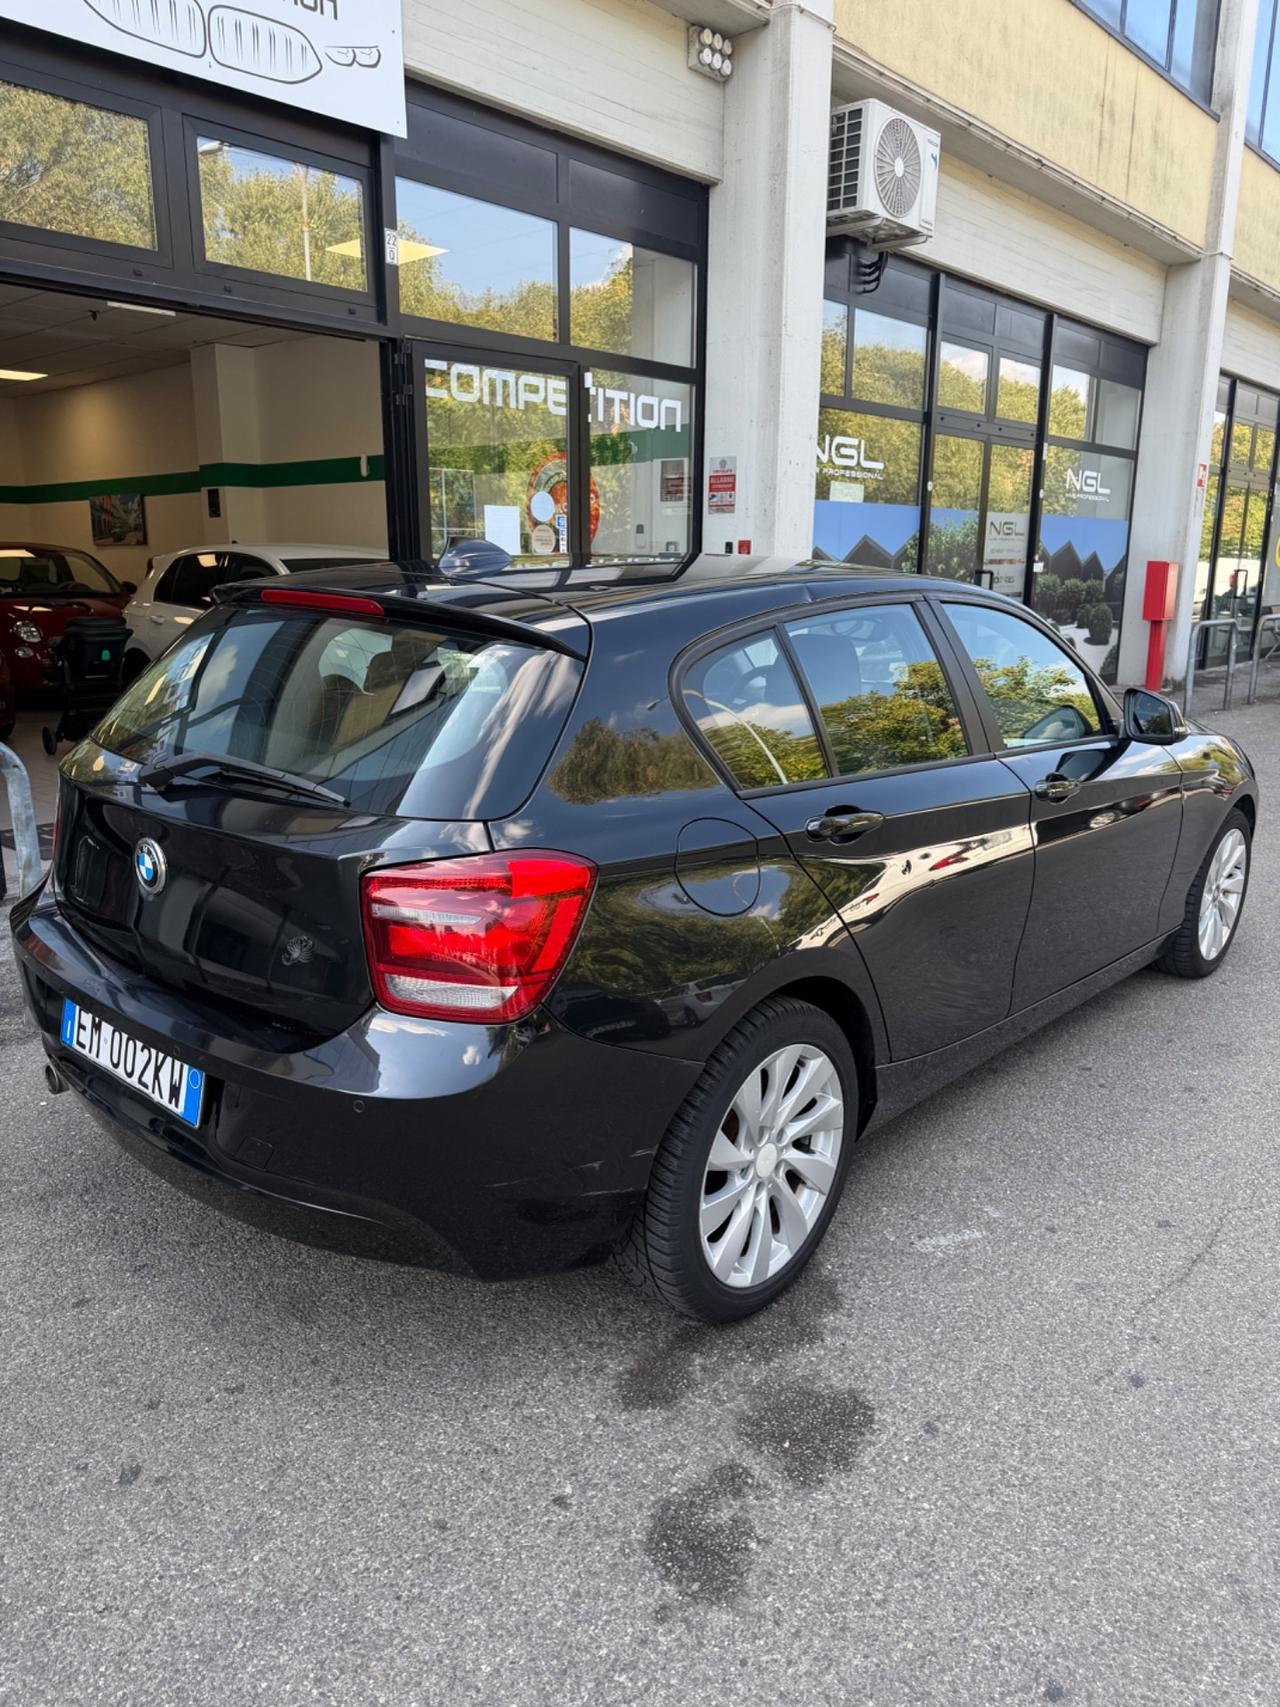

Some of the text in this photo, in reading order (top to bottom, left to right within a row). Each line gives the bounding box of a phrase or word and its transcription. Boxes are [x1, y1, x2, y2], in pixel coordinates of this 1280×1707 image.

[424, 358, 682, 432] COMPEITION
[1065, 467, 1111, 494] NGL
[989, 521, 1025, 536] NGL
